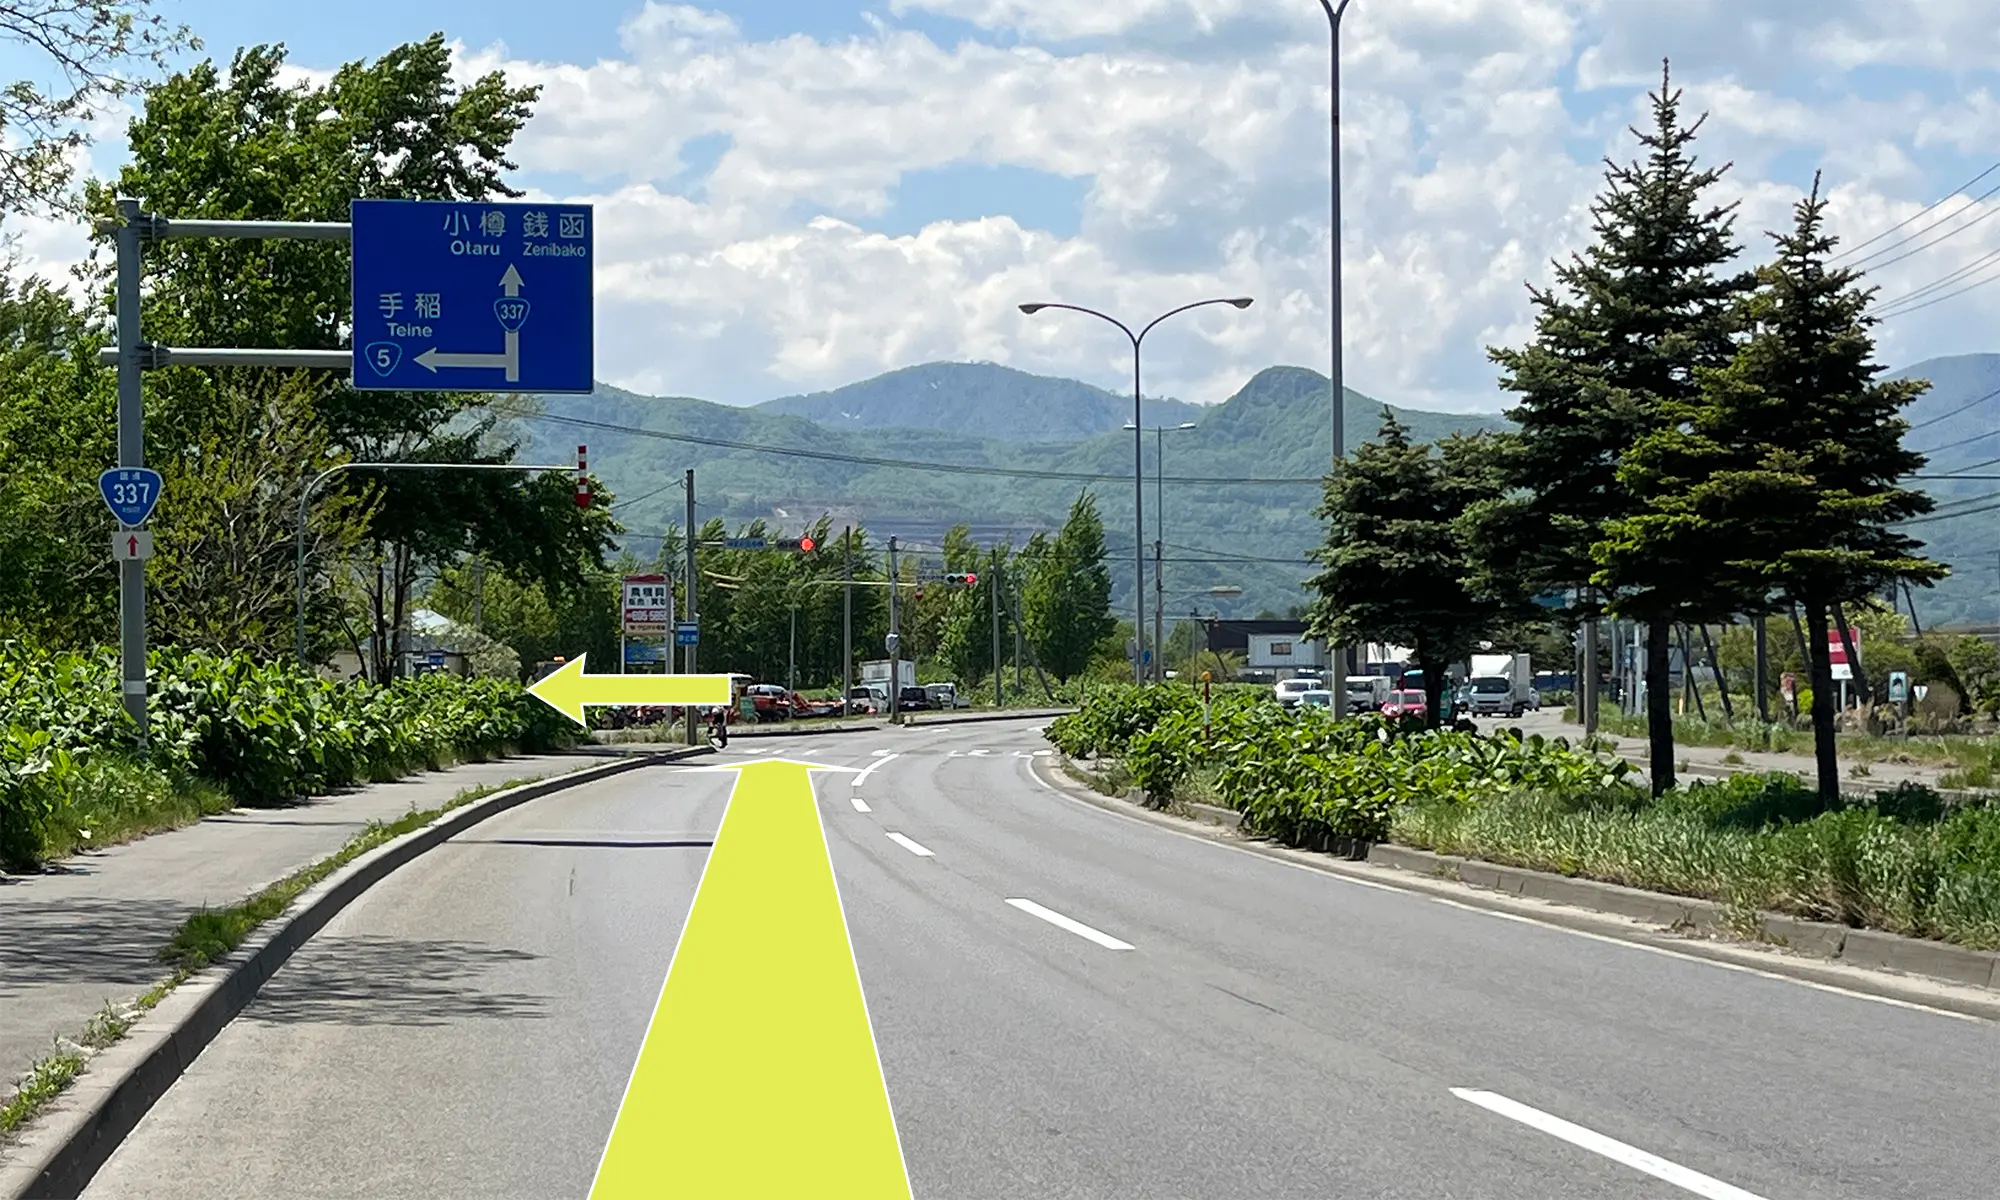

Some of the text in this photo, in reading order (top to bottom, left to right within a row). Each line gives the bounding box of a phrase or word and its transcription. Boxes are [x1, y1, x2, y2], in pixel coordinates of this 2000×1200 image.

[443, 210, 586, 239] 小樽 銭函
[450, 240, 587, 258] Otaru Zenibako
[378, 292, 442, 319] 手稲
[500, 304, 525, 320] 337
[386, 322, 433, 338] Teine
[376, 349, 391, 367] 5
[113, 483, 150, 504] 337
